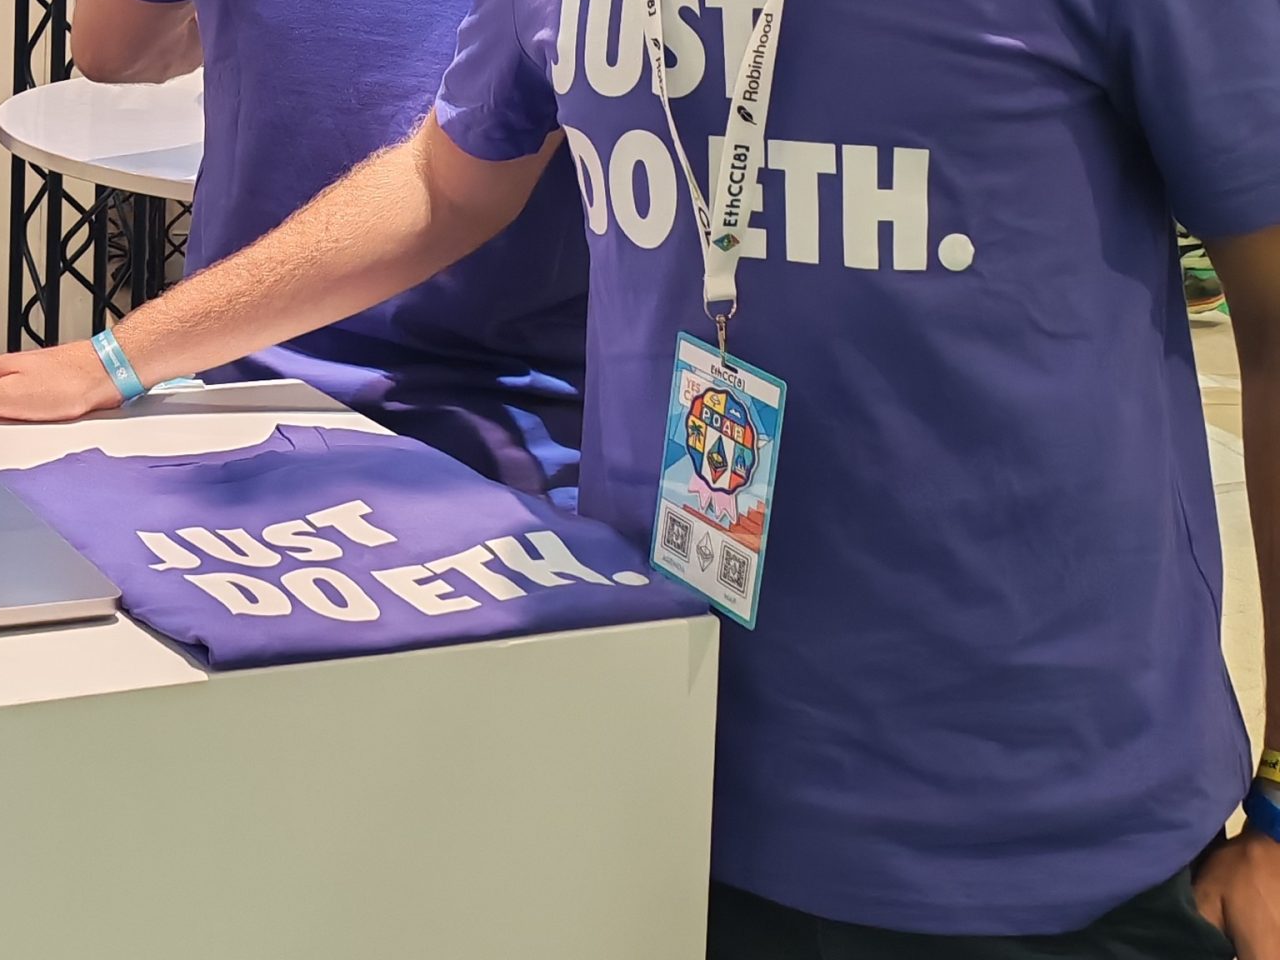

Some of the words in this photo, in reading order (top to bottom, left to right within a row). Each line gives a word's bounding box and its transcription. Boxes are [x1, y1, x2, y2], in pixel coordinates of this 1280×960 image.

[743, 12, 774, 102] Robinhood
[723, 144, 750, 228] EthCC[8]
[135, 499, 399, 571] JUST
[183, 566, 381, 622] DO
[370, 530, 651, 617] ETH.
